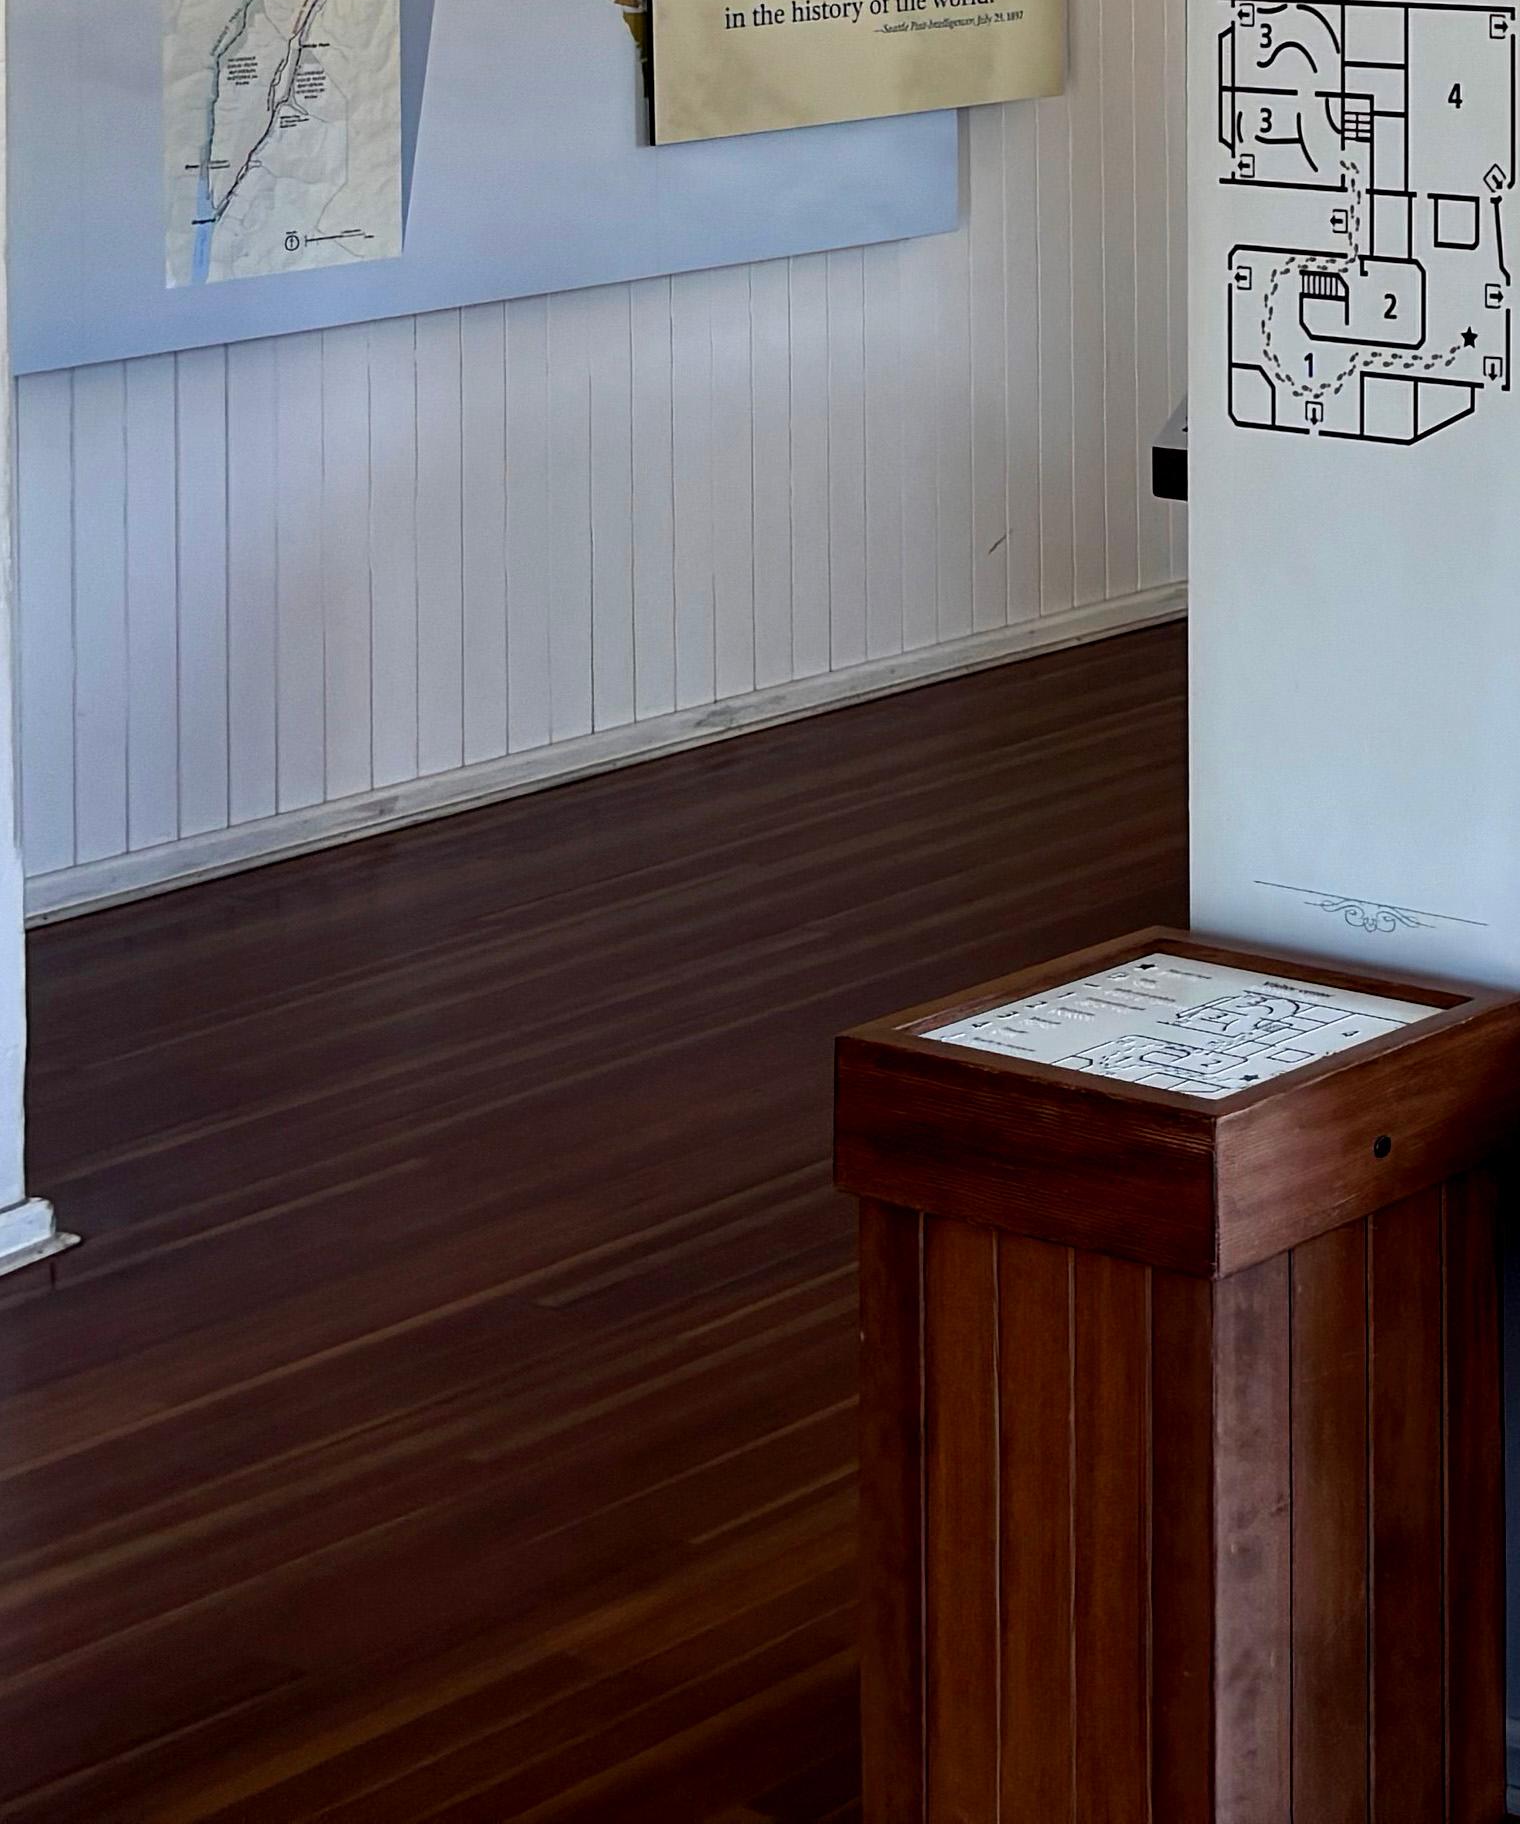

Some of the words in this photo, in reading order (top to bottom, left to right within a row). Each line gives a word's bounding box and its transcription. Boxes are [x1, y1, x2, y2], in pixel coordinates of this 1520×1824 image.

[724, 7, 746, 30] in
[752, 3, 785, 26] the
[1260, 23, 1272, 49] 3
[1447, 82, 1463, 109] 4
[1260, 107, 1272, 133] 3
[1383, 293, 1398, 320] 2
[1304, 352, 1314, 378] 1
